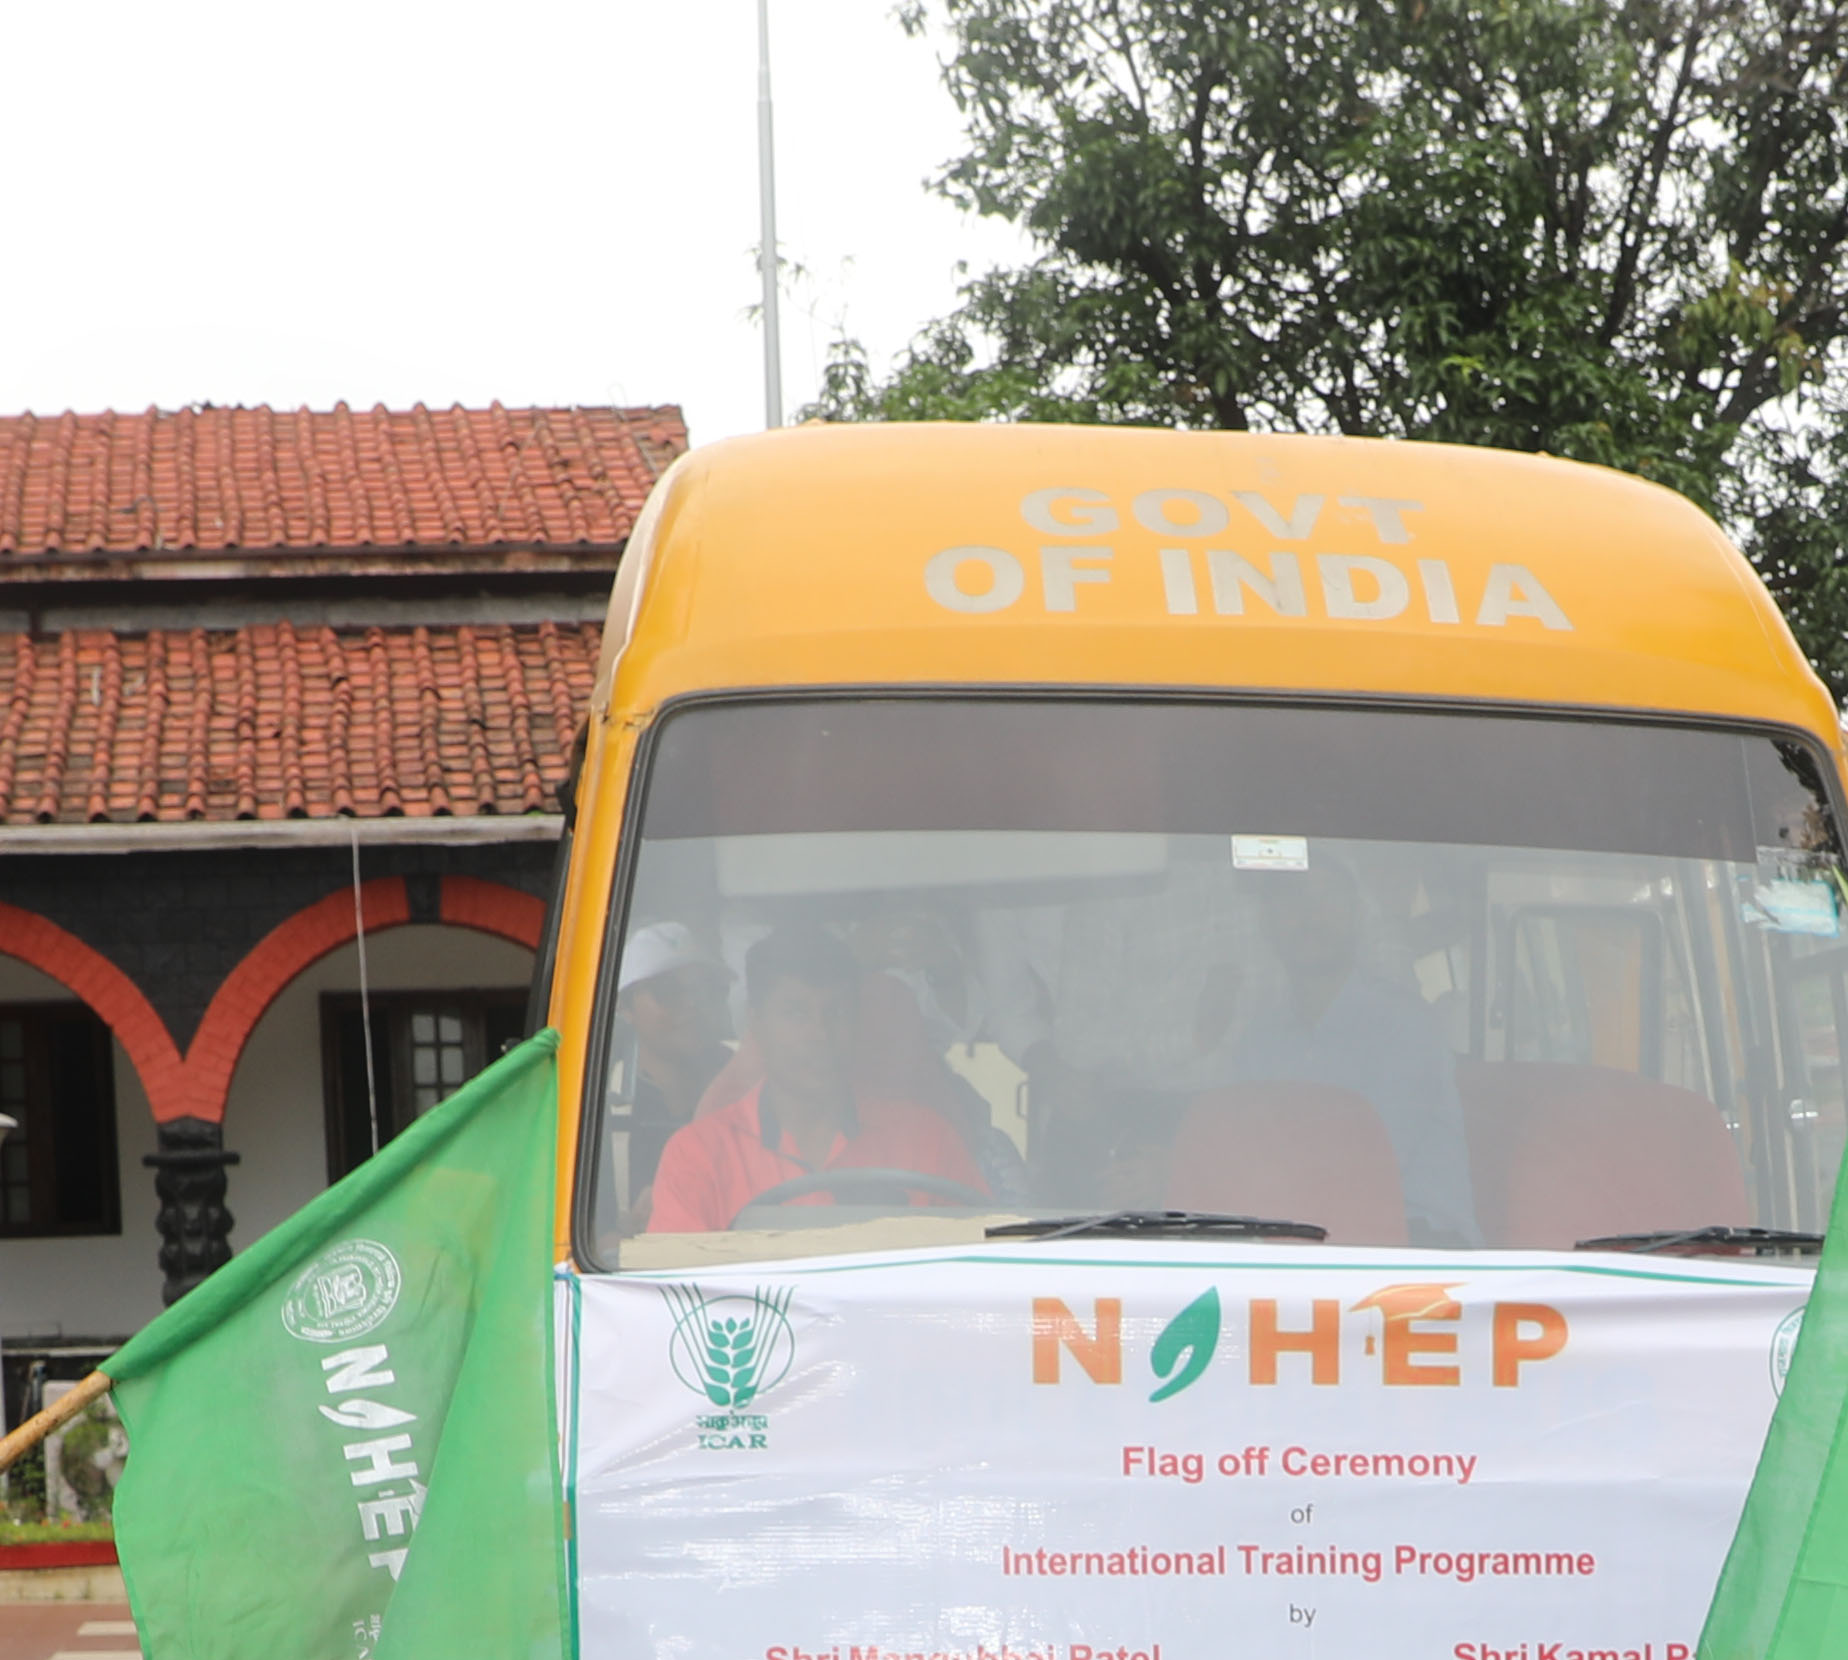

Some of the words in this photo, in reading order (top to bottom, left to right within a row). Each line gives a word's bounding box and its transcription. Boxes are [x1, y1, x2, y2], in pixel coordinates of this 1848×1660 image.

[1018, 486, 1425, 545] GOVT
[923, 545, 1114, 614] OF
[1158, 548, 1575, 631] INDIA
[697, 1433, 768, 1449] ICAR
[1123, 1446, 1204, 1484] Flag
[1218, 1446, 1270, 1476] off
[1281, 1446, 1477, 1485] Ceremony
[1290, 1503, 1314, 1524] of
[1003, 1545, 1225, 1576] International
[1237, 1545, 1382, 1583] Training
[1395, 1545, 1595, 1583] Programme
[1289, 1603, 1317, 1628] by
